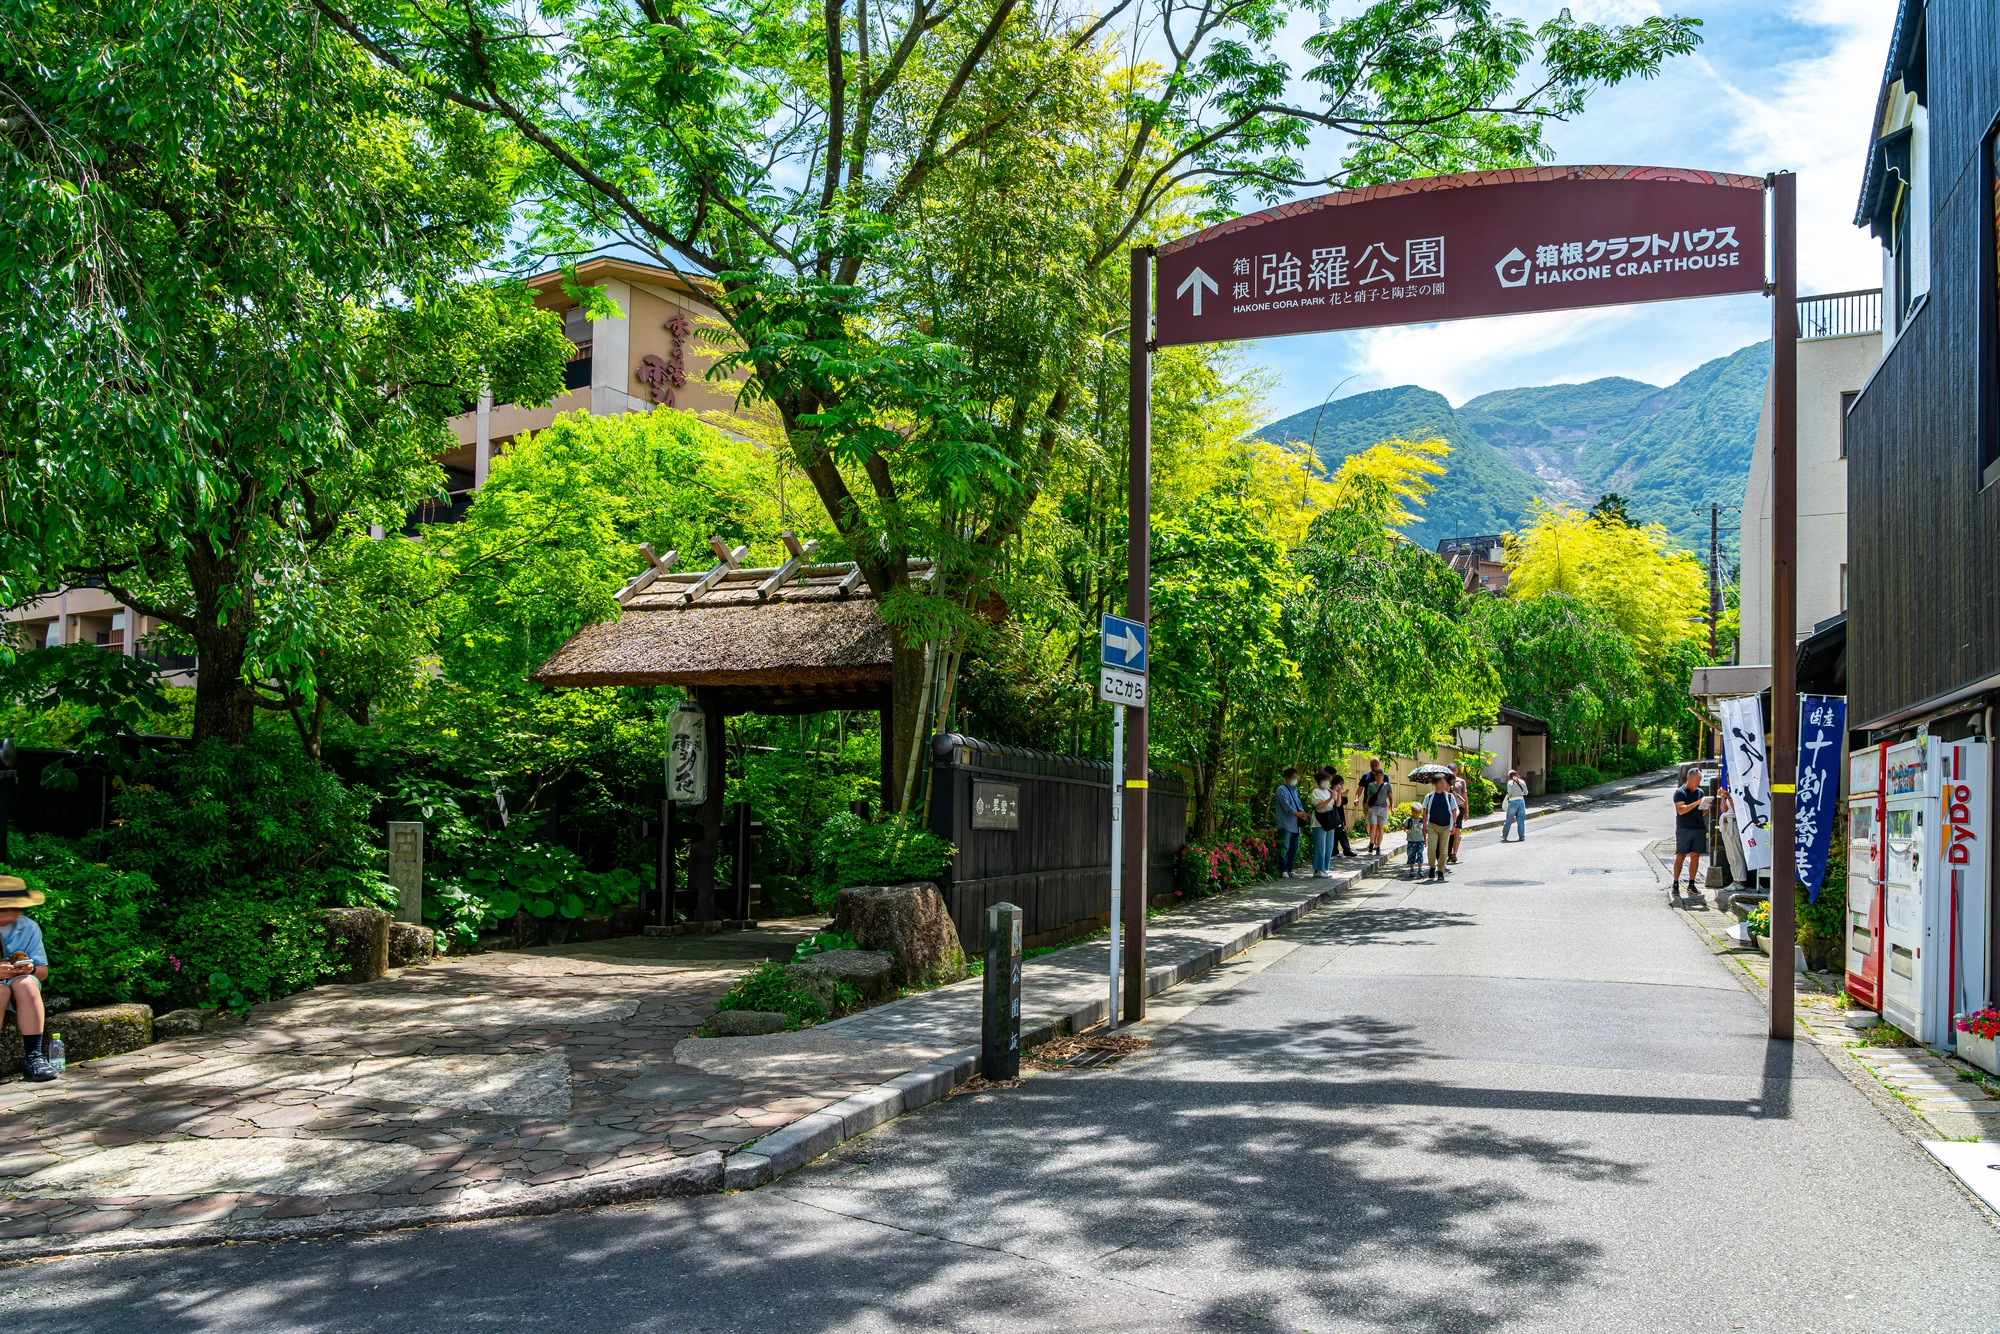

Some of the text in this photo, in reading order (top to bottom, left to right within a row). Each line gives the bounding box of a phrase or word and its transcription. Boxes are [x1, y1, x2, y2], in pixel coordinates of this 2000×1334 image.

[1535, 226, 1740, 268] 箱根クラフトハウス
[1232, 257, 1250, 300] 箱根
[1261, 235, 1445, 296] 強羅公園
[1534, 252, 1740, 285] HAKONE CRAFTHOUSE
[1233, 296, 1325, 313] HAKONE GORA PARK
[1328, 282, 1445, 306] 花と硝子と陶芸の園
[1104, 676, 1144, 700] ここから
[1809, 706, 1835, 728] 国産
[1948, 784, 1977, 865] DyDo
